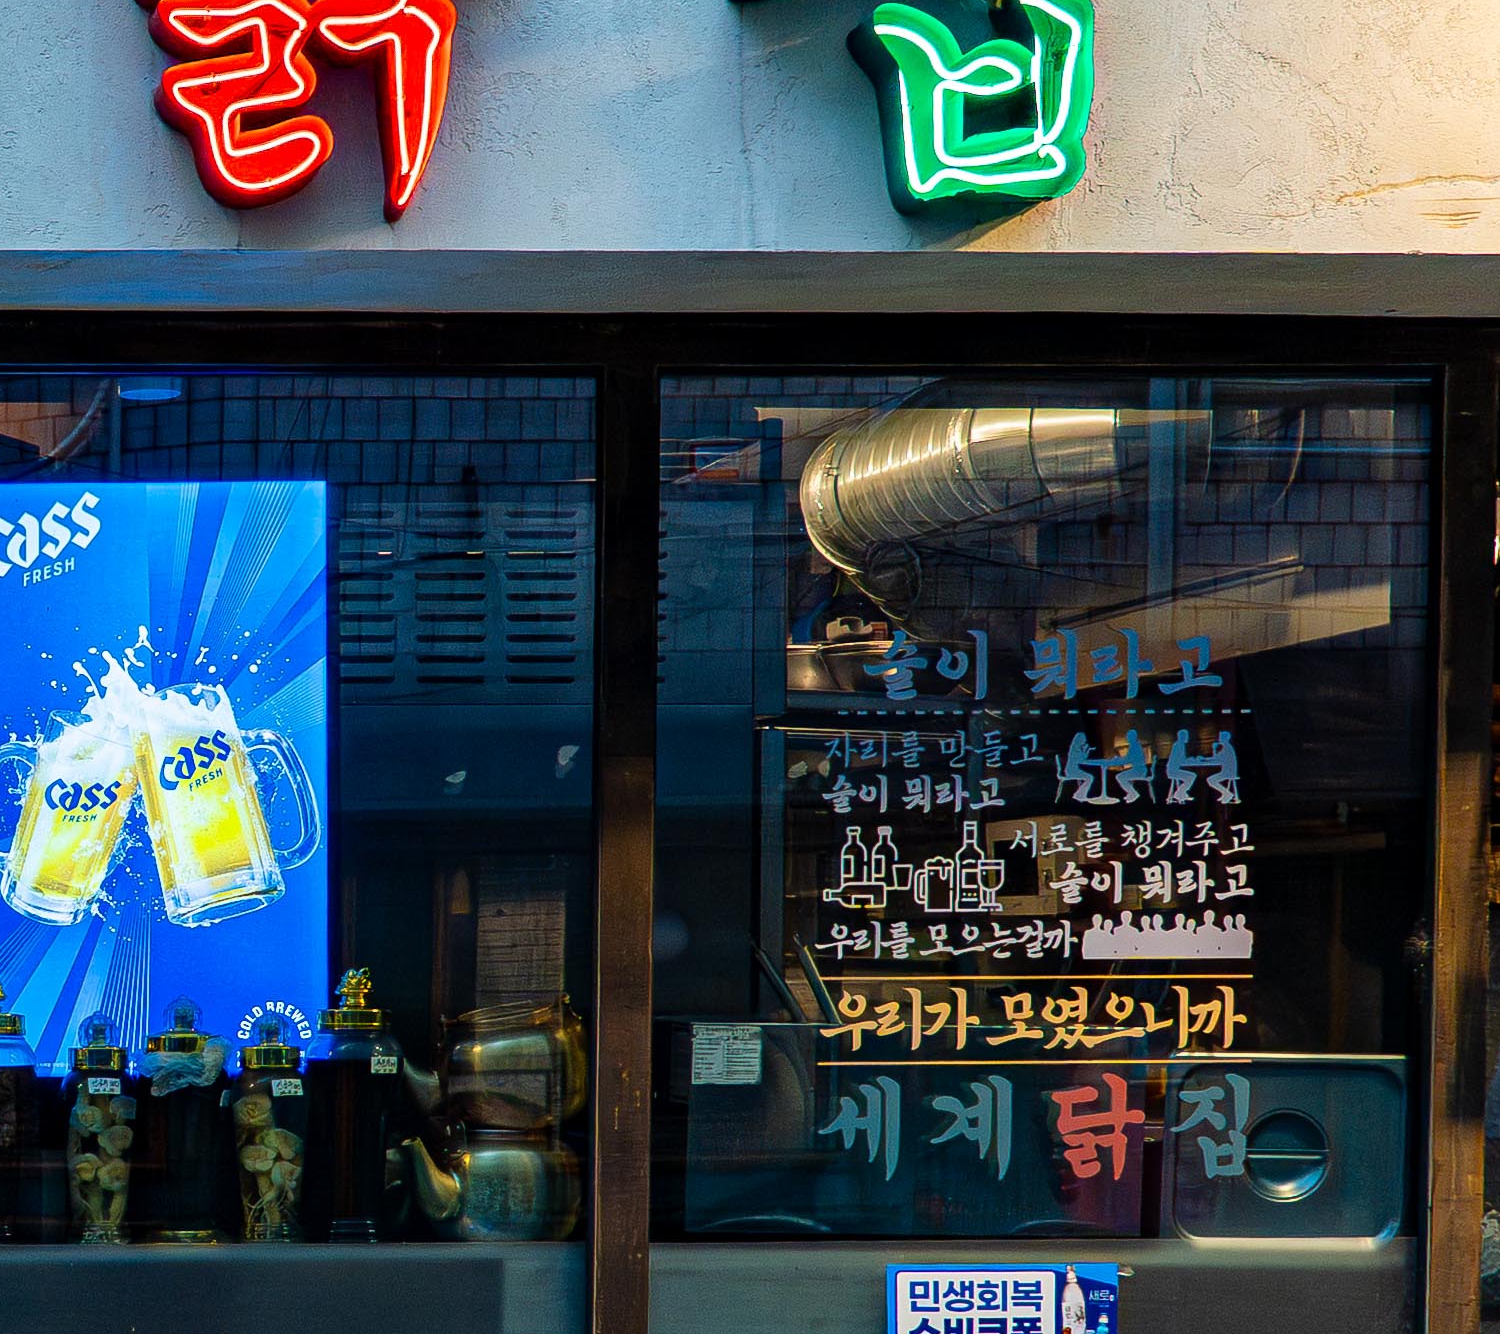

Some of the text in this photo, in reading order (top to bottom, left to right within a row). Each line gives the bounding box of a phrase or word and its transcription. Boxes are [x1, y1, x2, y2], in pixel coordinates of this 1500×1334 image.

[23, 557, 75, 587] FRESH
[863, 628, 1223, 701] 술이 뭐라고
[824, 731, 1045, 768] 자리를 만들고
[189, 768, 223, 792] FRESH
[822, 773, 1006, 814] 술이 뭐라고
[62, 814, 98, 822] FRESH
[1009, 820, 1255, 859] 서로를 챙겨주고
[1049, 860, 1255, 904] 술이 뭐라고
[815, 919, 1078, 960] 우리를 모으는걸까
[238, 1006, 263, 1039] COLD
[819, 985, 1247, 1052] 우리가 모였으니까
[909, 1280, 1044, 1313] 민생회복
